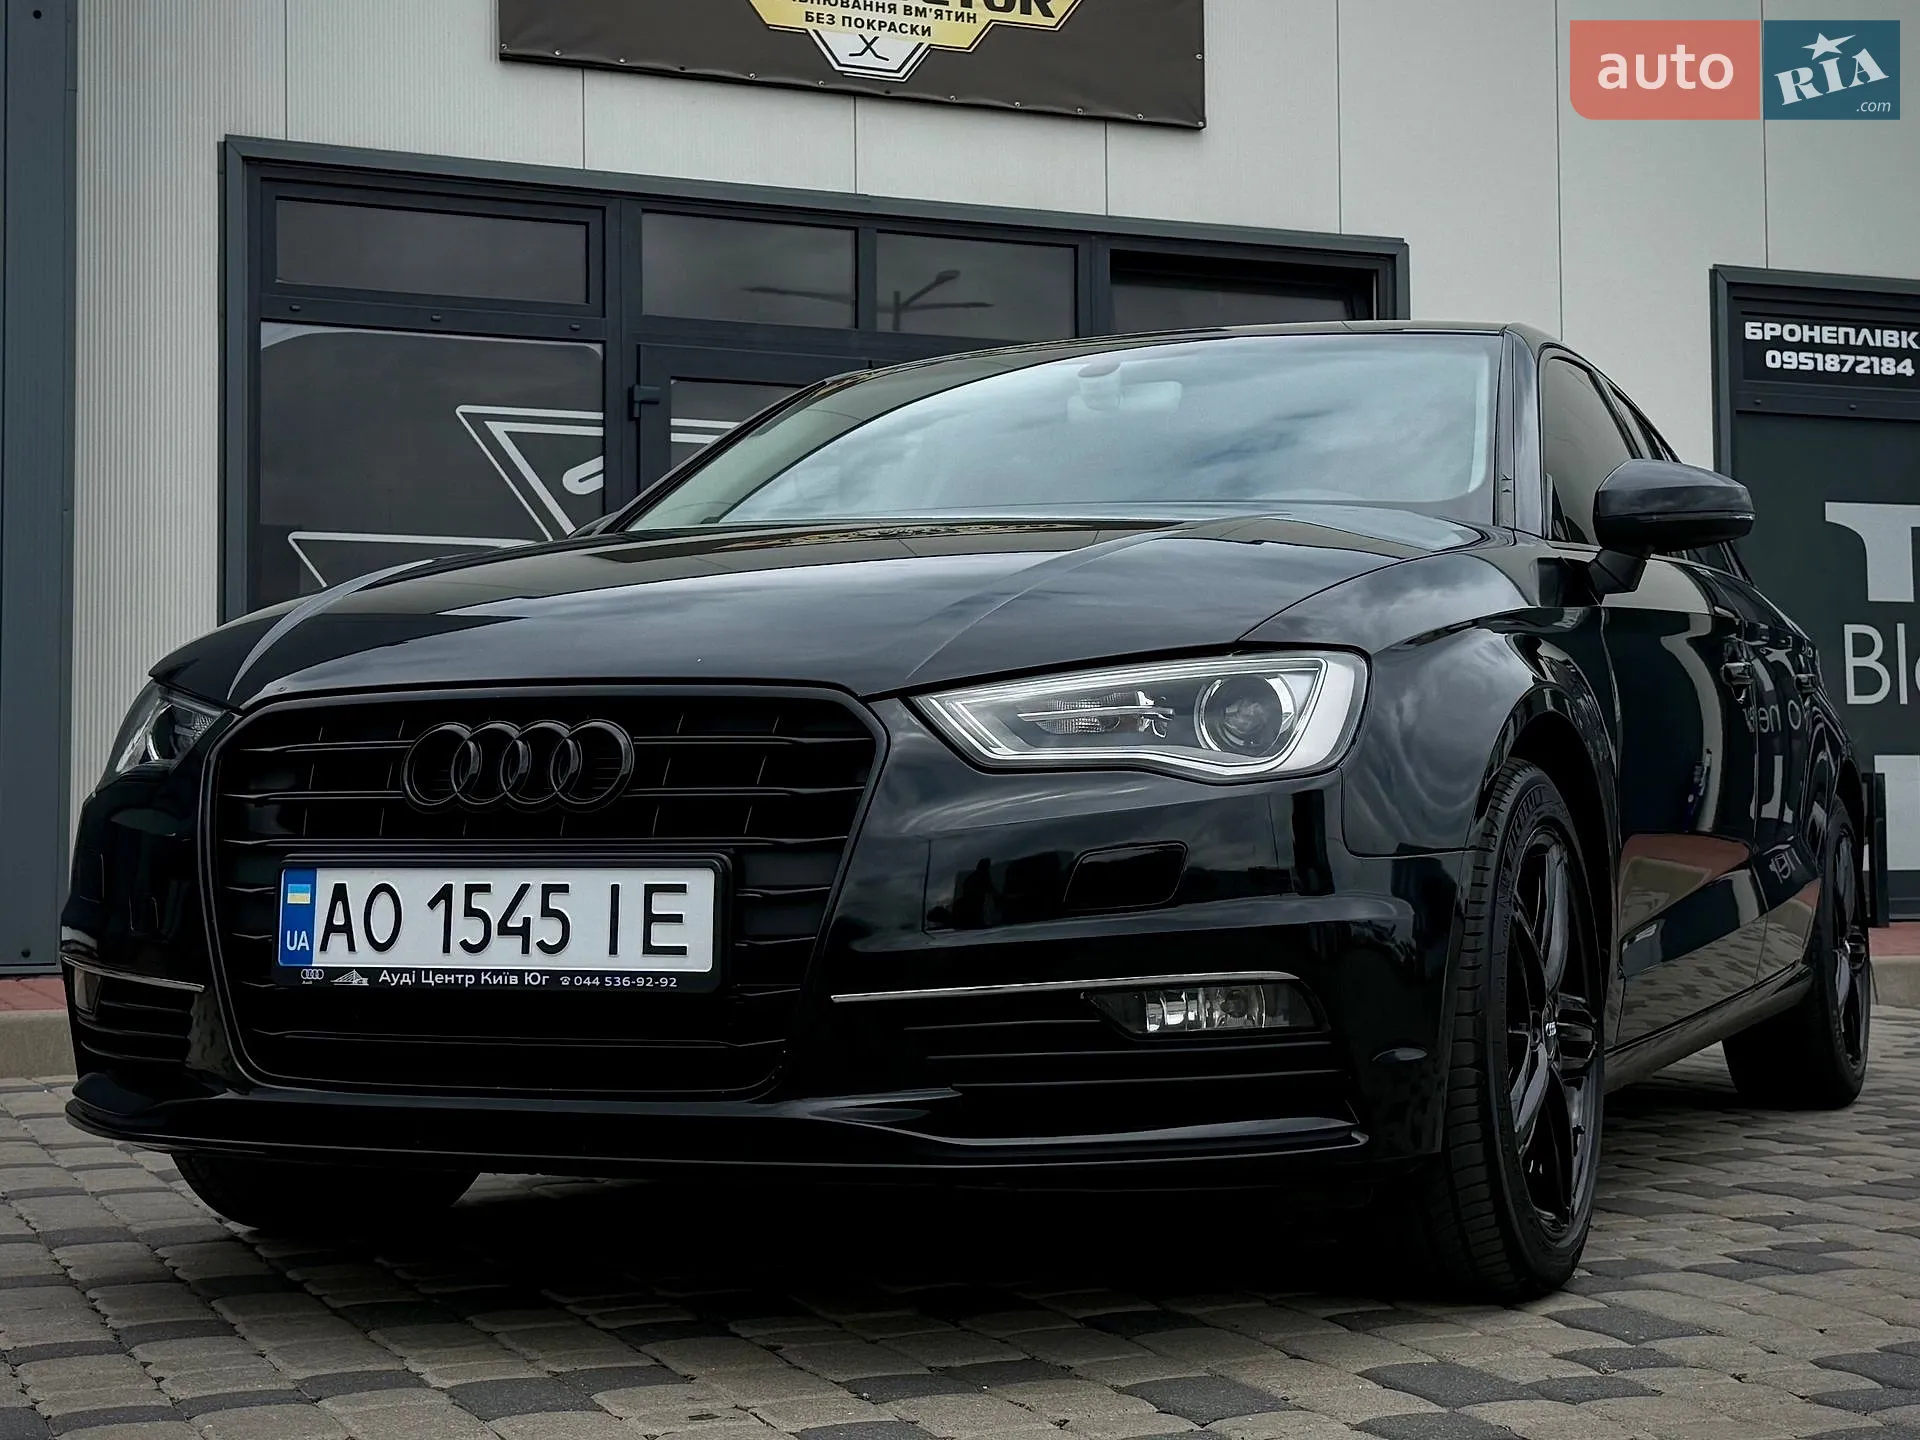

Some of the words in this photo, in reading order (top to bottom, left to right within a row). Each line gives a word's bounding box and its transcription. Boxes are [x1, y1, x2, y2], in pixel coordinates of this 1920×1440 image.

[804, 10, 836, 25] БЕЗ
[841, 15, 932, 37] ПОКРАСКИ
[902, 4, 977, 24] ВМ'ЯТИН
[1765, 349, 1916, 377] 0951872184
[1842, 622, 1920, 706] Bl
[319, 882, 403, 953] AO
[426, 883, 571, 955] 1545
[608, 883, 688, 956] IE
[286, 930, 310, 951] UA
[378, 969, 416, 986] Ауді
[420, 970, 476, 988] Центр
[480, 972, 519, 986] Київ
[523, 972, 550, 986] Юг
[573, 976, 601, 987] 044
[604, 976, 678, 988] 536-92-92
